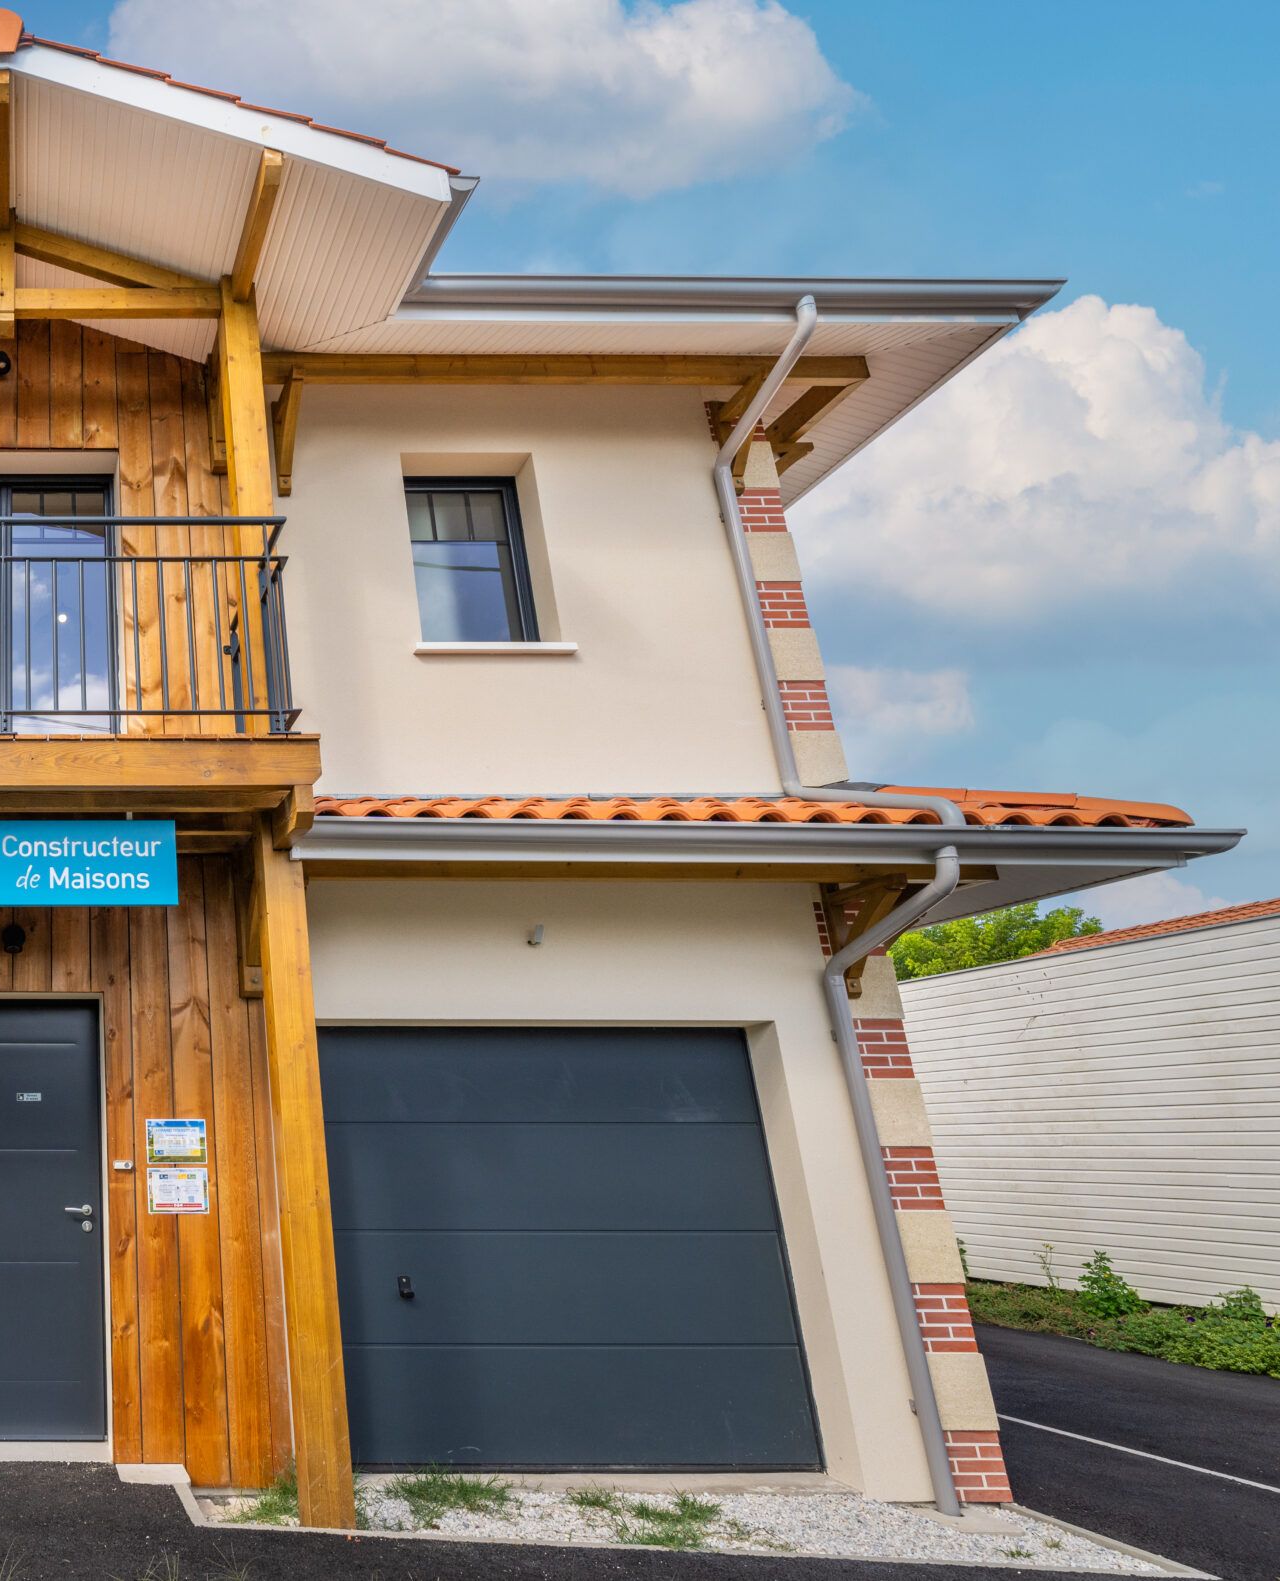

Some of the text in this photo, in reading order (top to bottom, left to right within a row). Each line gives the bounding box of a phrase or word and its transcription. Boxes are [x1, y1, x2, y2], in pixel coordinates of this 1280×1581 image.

[2, 835, 161, 857] Constructeur
[15, 864, 150, 890] de Maisons
